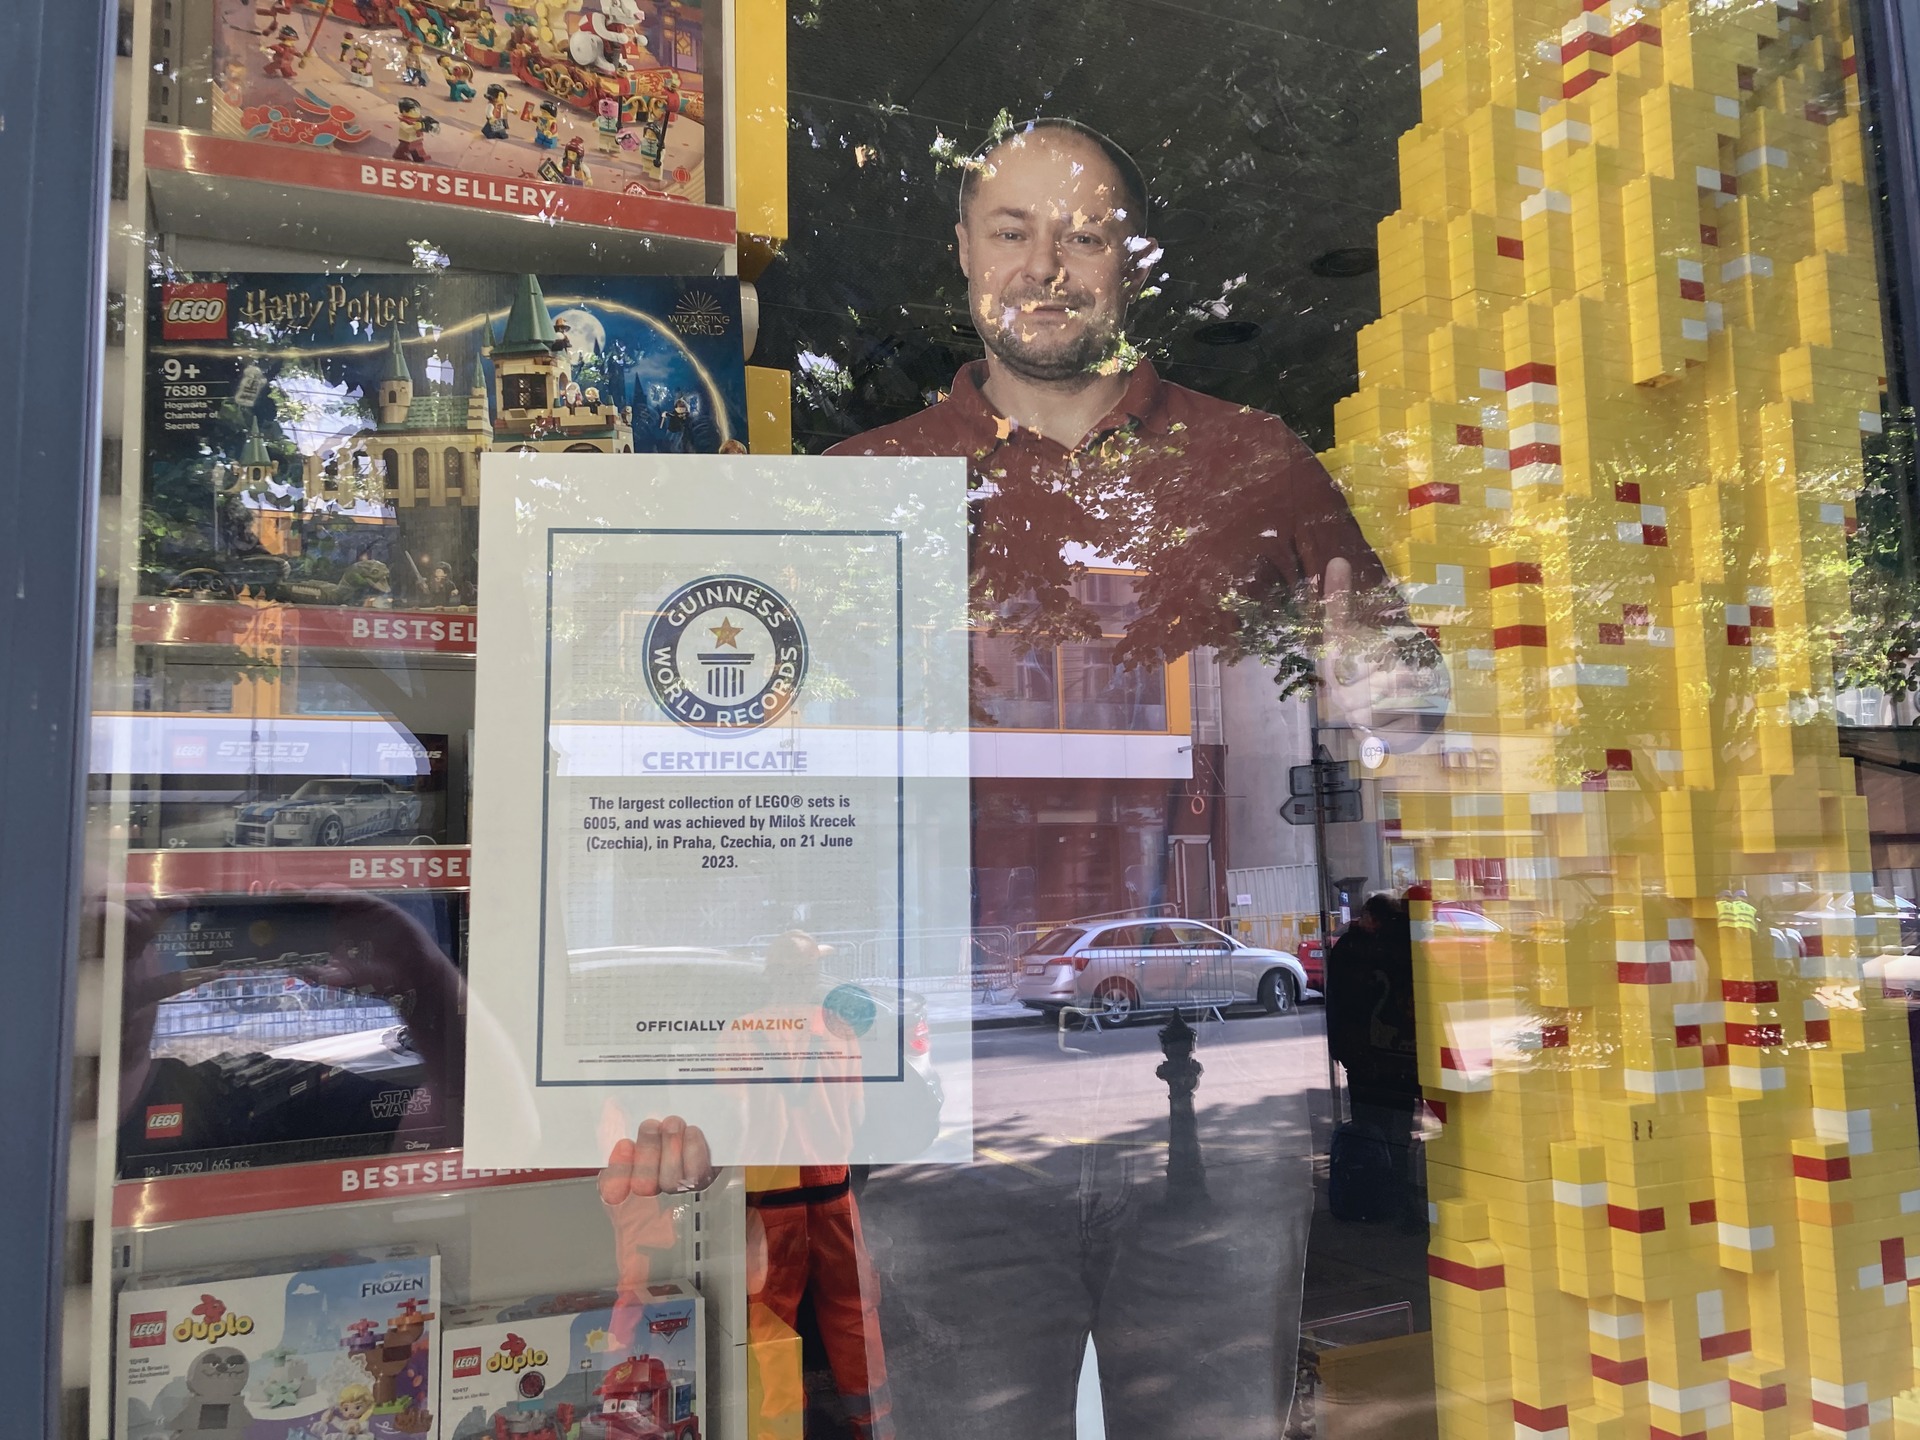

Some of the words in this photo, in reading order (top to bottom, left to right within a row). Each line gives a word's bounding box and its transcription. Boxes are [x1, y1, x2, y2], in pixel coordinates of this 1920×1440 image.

[361, 165, 556, 208] BESTSELLERY
[166, 299, 224, 323] LEGO
[239, 288, 323, 330] Harry
[328, 284, 409, 328] Potter
[668, 315, 730, 325] WIZARDING
[676, 324, 725, 335] WORLD
[164, 359, 200, 381] 9+
[164, 385, 207, 397] 76389
[164, 411, 207, 420] Chamber
[209, 411, 218, 419] of
[165, 422, 200, 430] Secrets
[668, 585, 786, 628] GUINNESS
[654, 647, 706, 721] WORLD
[717, 647, 797, 727] RECORDS
[217, 741, 309, 756] SPEED
[642, 750, 807, 771] CERTIFICATE
[590, 797, 614, 809] The
[618, 797, 664, 812] largest
[668, 796, 734, 809] collection
[738, 795, 752, 809] of
[755, 795, 803, 808] LEGO®
[807, 796, 835, 808] sets
[839, 795, 850, 808] is
[583, 816, 620, 831] 6005,
[624, 816, 649, 829] and
[653, 818, 681, 829] was
[686, 815, 746, 829] achieved
[750, 815, 766, 831] by
[769, 814, 805, 828] Miloš
[810, 814, 856, 828] Krecek
[168, 838, 188, 848] 9+
[586, 836, 652, 852] (Czechia),
[657, 836, 668, 849] in
[673, 836, 716, 850] Praha,
[720, 835, 776, 850] Czechia,
[780, 837, 796, 848] on
[801, 835, 815, 847] 21
[820, 834, 853, 847] June
[701, 856, 738, 868] 2023.
[203, 931, 232, 939] STAR
[208, 940, 234, 949] RUN
[636, 1020, 726, 1032] OFFICIALLY
[371, 1088, 431, 1104] STAR
[371, 1101, 431, 1118] WARS
[148, 1113, 181, 1128] LEGO
[144, 1166, 161, 1177] 18+
[362, 1277, 423, 1297] FROZEN
[133, 1322, 163, 1337] LEGO
[173, 1312, 254, 1344] duplo
[455, 1356, 479, 1369] LEGO
[487, 1347, 548, 1373] duplo
